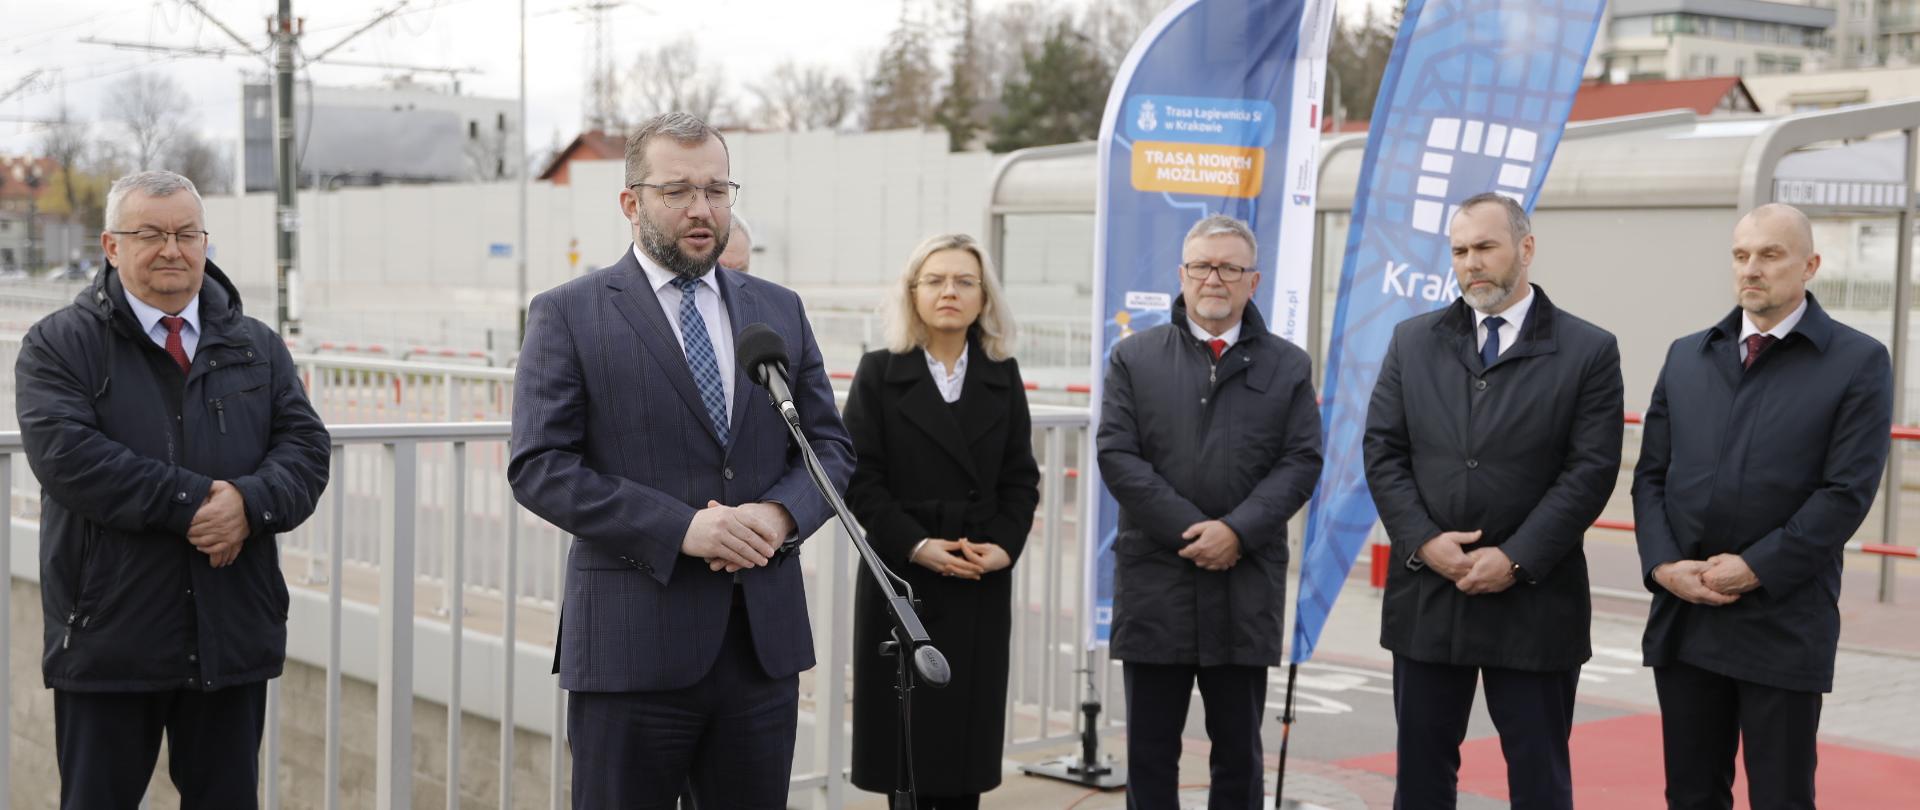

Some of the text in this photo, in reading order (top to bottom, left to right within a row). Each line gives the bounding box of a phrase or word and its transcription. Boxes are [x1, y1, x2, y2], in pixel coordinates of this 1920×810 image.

[1165, 106, 1192, 118] Trasa
[1165, 120, 1223, 132] w Krakowie
[1145, 150, 1195, 165] TRASA
[1382, 260, 1462, 302] Krak
